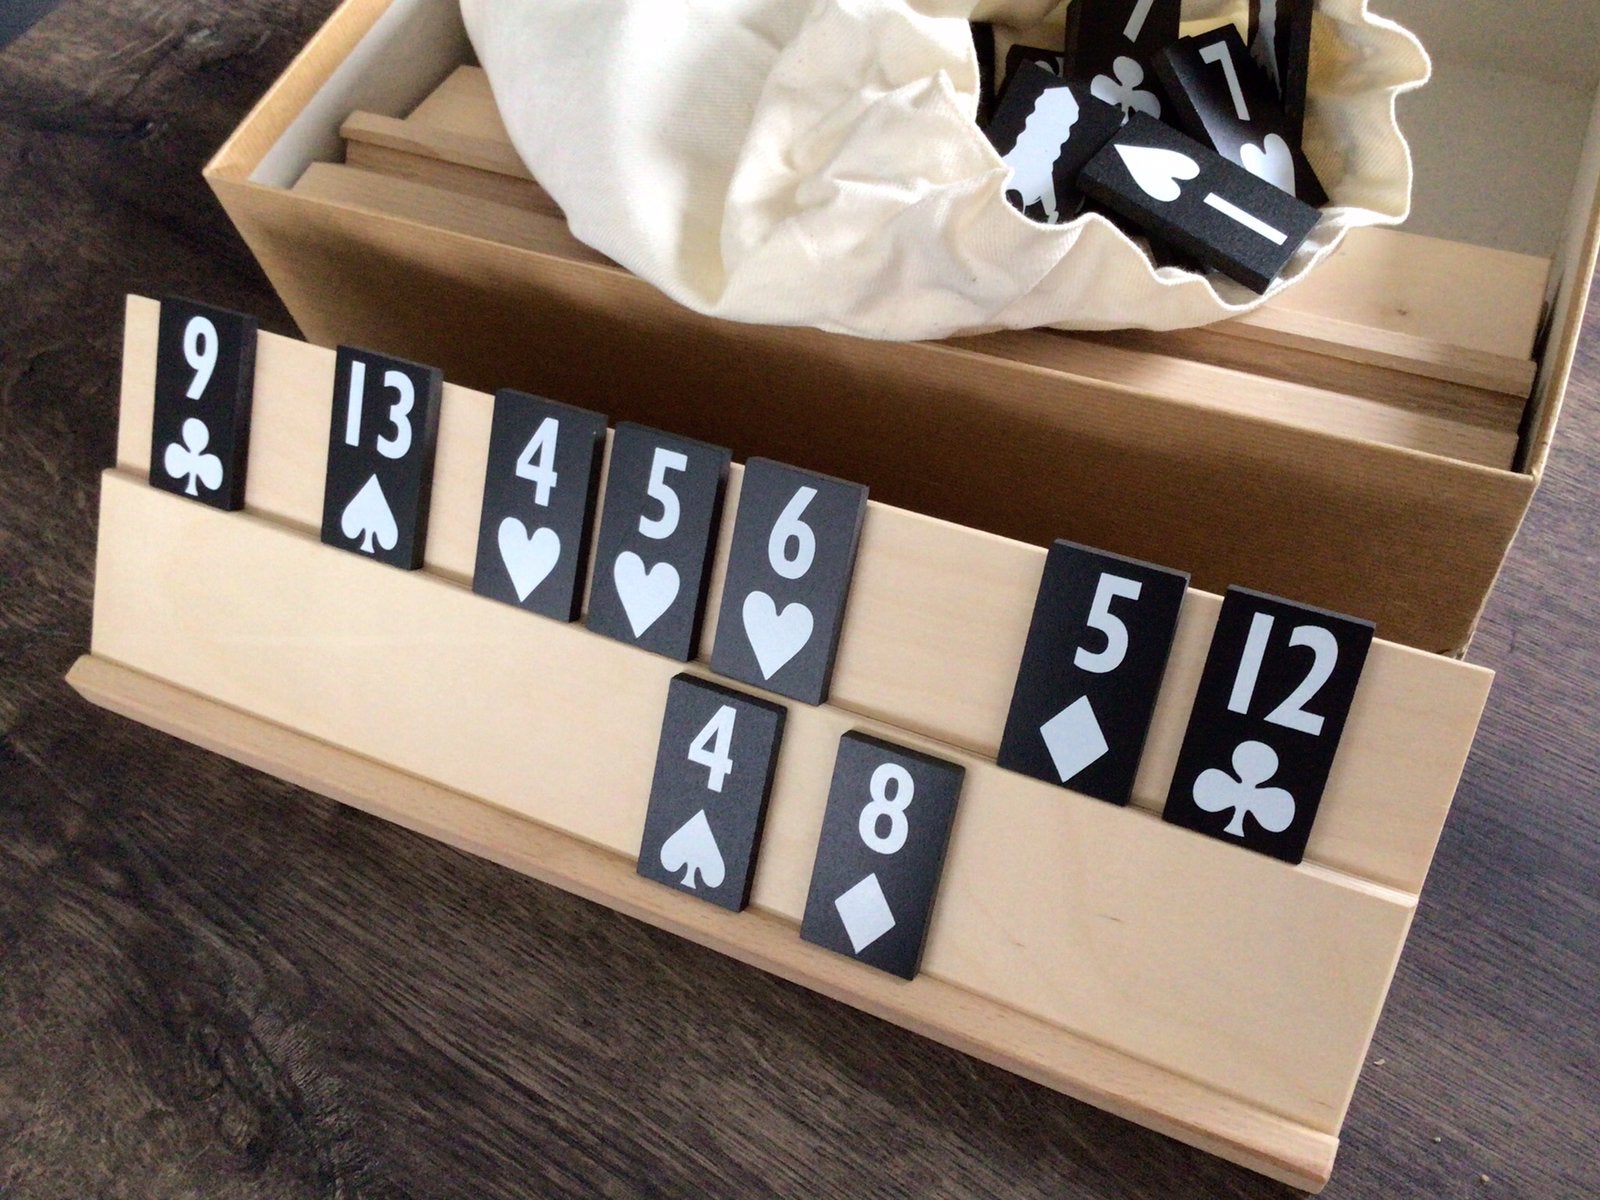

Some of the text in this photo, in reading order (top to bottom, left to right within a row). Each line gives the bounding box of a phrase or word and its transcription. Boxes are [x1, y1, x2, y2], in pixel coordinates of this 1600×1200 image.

[1199, 41, 1250, 122] 7
[183, 315, 219, 401] 9
[345, 360, 415, 459] 13
[515, 416, 560, 507] 4
[638, 446, 688, 540] 5
[767, 485, 818, 580] 6
[1073, 572, 1143, 674] 5
[1227, 612, 1339, 736] 12
[687, 704, 737, 793] 4
[858, 762, 915, 855] 8
